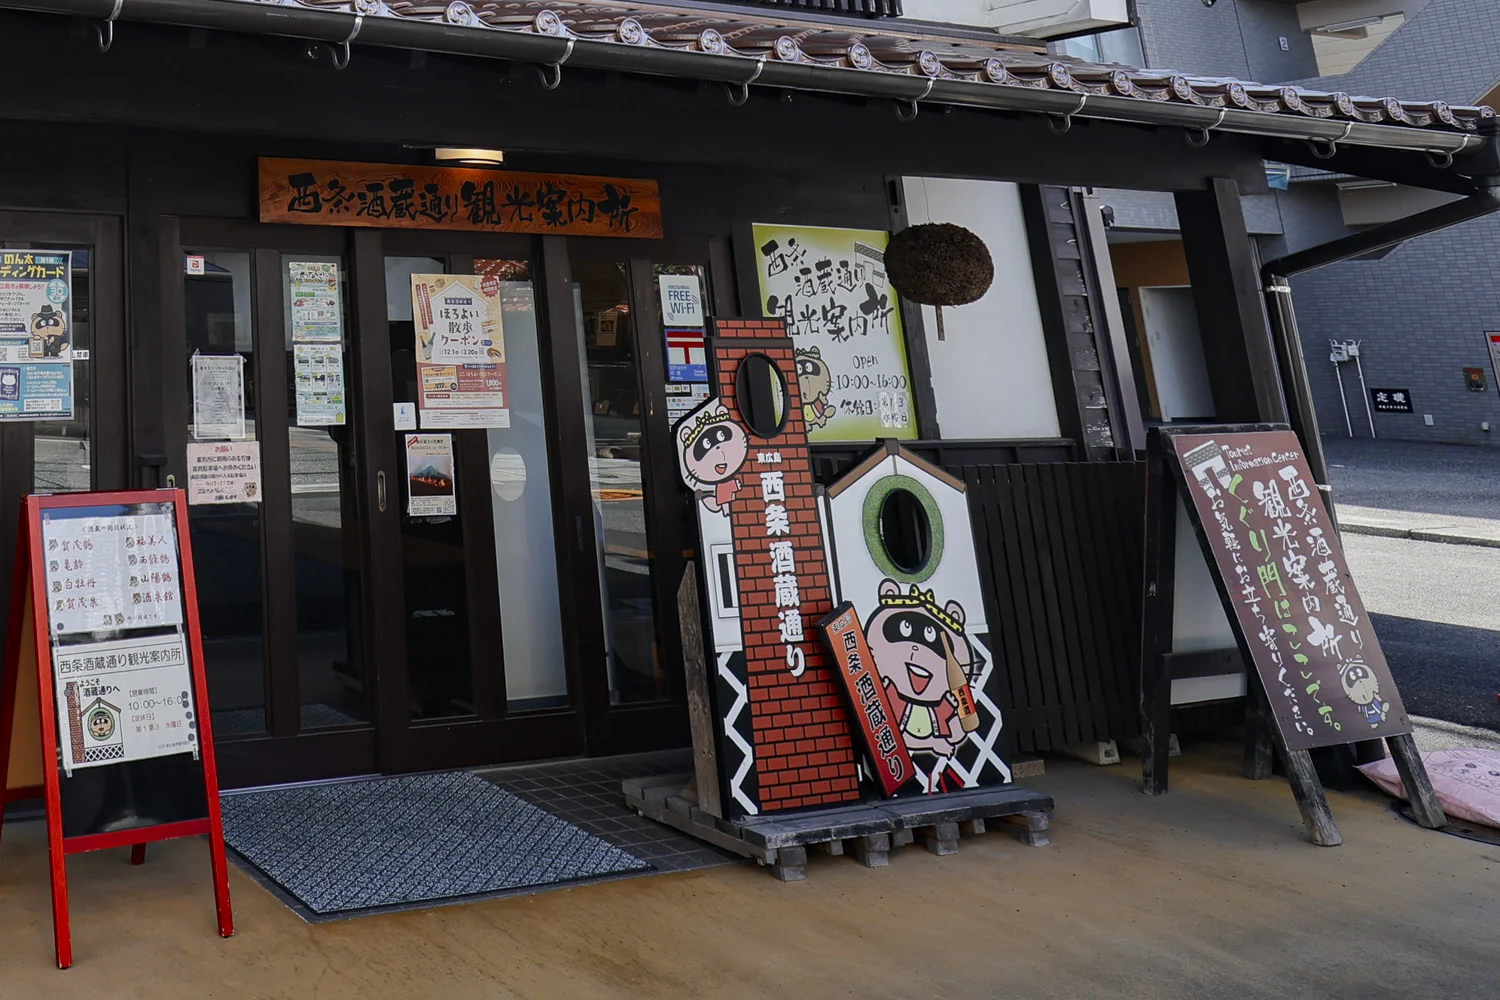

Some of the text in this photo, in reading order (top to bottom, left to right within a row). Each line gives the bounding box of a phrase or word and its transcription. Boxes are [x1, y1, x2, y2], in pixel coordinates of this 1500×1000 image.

[287, 172, 638, 232] 西条酒蔵通り観光案内所
[4, 254, 33, 265] のん太
[761, 237, 807, 278] 西条
[794, 255, 864, 298] 酒蔵通り
[668, 290, 691, 301] FREE
[440, 308, 479, 320] ほろよい
[670, 302, 695, 314] Wi-Fi
[767, 282, 894, 344] 観光案内所
[448, 321, 473, 334] 散歩
[441, 335, 479, 346] クーポン
[852, 355, 879, 370] Open
[756, 451, 782, 464] 東広島
[1221, 444, 1253, 459] Tourist
[1229, 451, 1299, 472] Information Center
[62, 535, 168, 551] 賀茂鶴 福美人
[1277, 465, 1365, 649] 西条酒蔵通り
[760, 470, 805, 677] 西条酒蔵通り
[1253, 479, 1343, 660] 観光案内所
[65, 572, 172, 589] 白牡丹 山陽鶴
[66, 596, 99, 610] 賀茂泉
[60, 647, 181, 674] 西条酒蔵通り観光案内所
[79, 678, 100, 687] ようこそ
[83, 685, 120, 697] 酒蔵通りへ
[843, 630, 904, 782] 西条酒蔵通り
